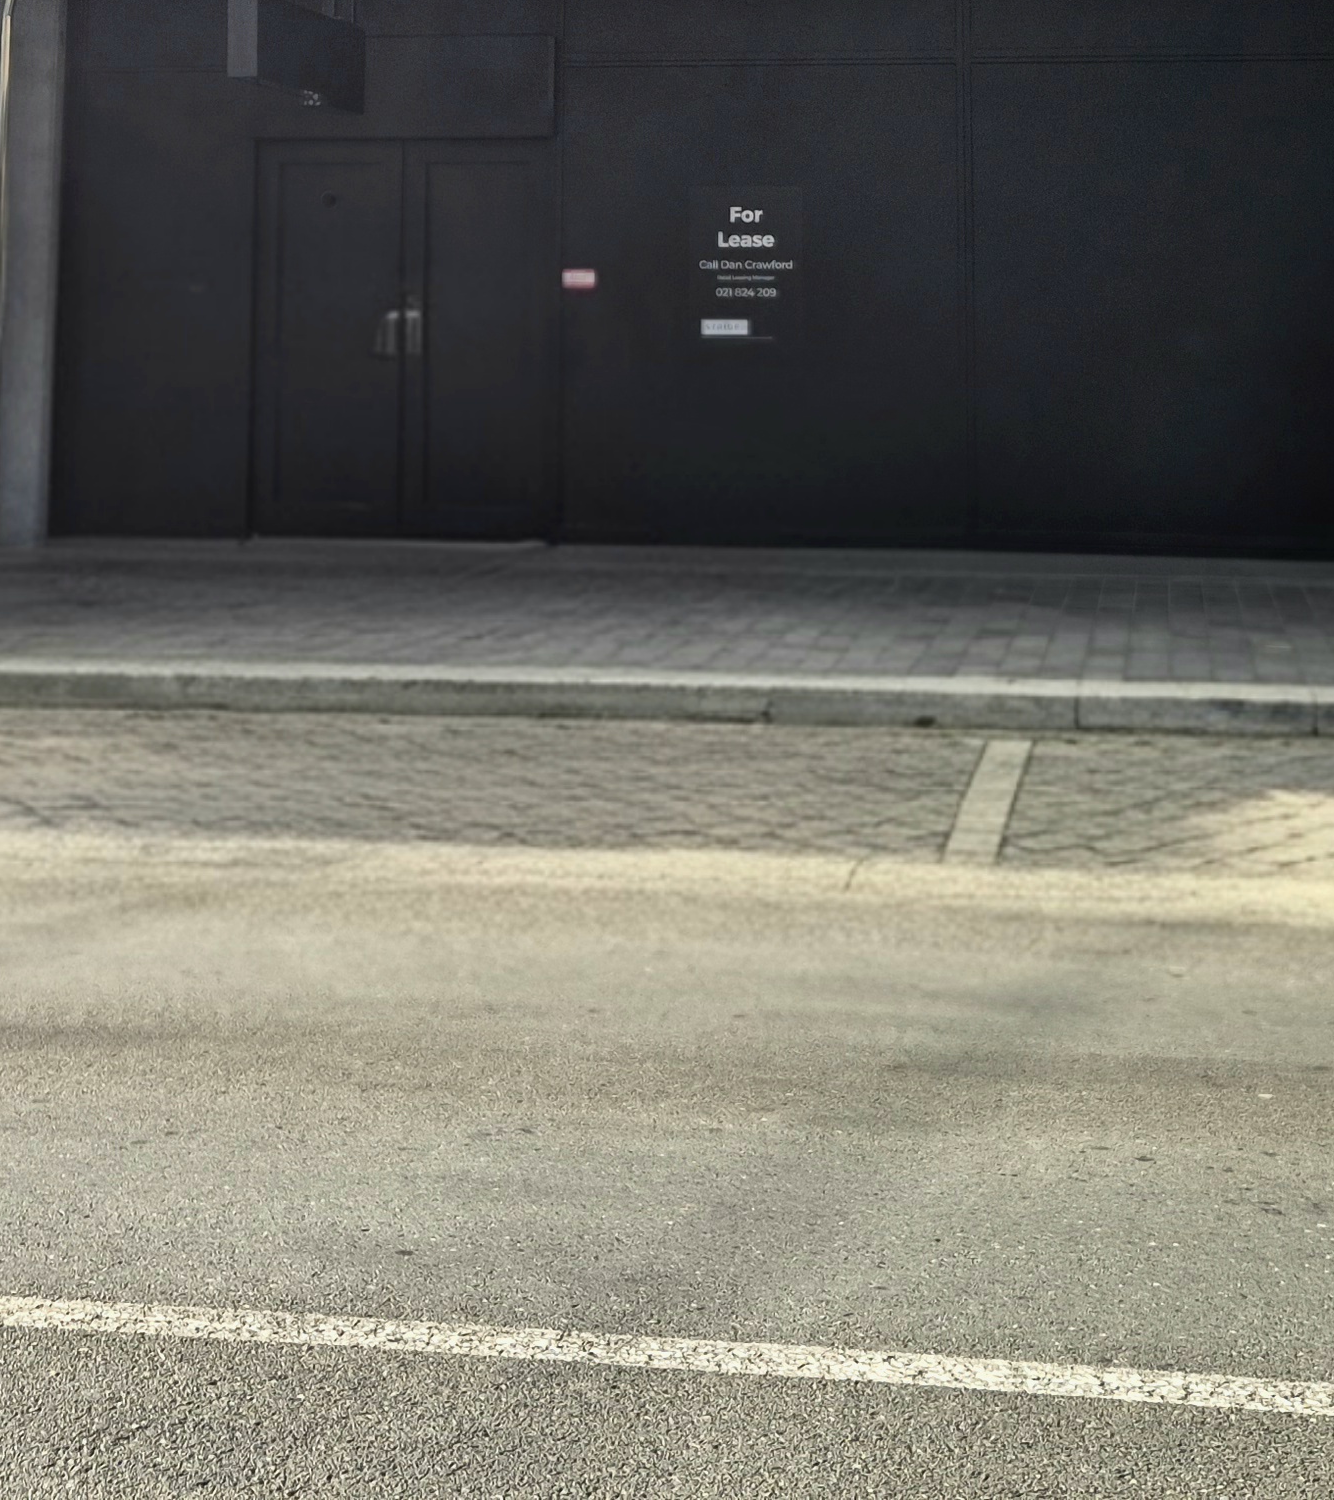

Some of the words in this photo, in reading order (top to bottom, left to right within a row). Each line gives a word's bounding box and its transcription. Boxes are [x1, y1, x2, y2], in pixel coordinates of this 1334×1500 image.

[729, 206, 764, 224] For
[717, 231, 775, 248] Lease
[699, 260, 719, 270] Call
[721, 260, 743, 270] Dan
[744, 260, 794, 270] Crawford
[716, 288, 733, 298] 021
[734, 288, 755, 298] 824
[757, 288, 777, 298] 209
